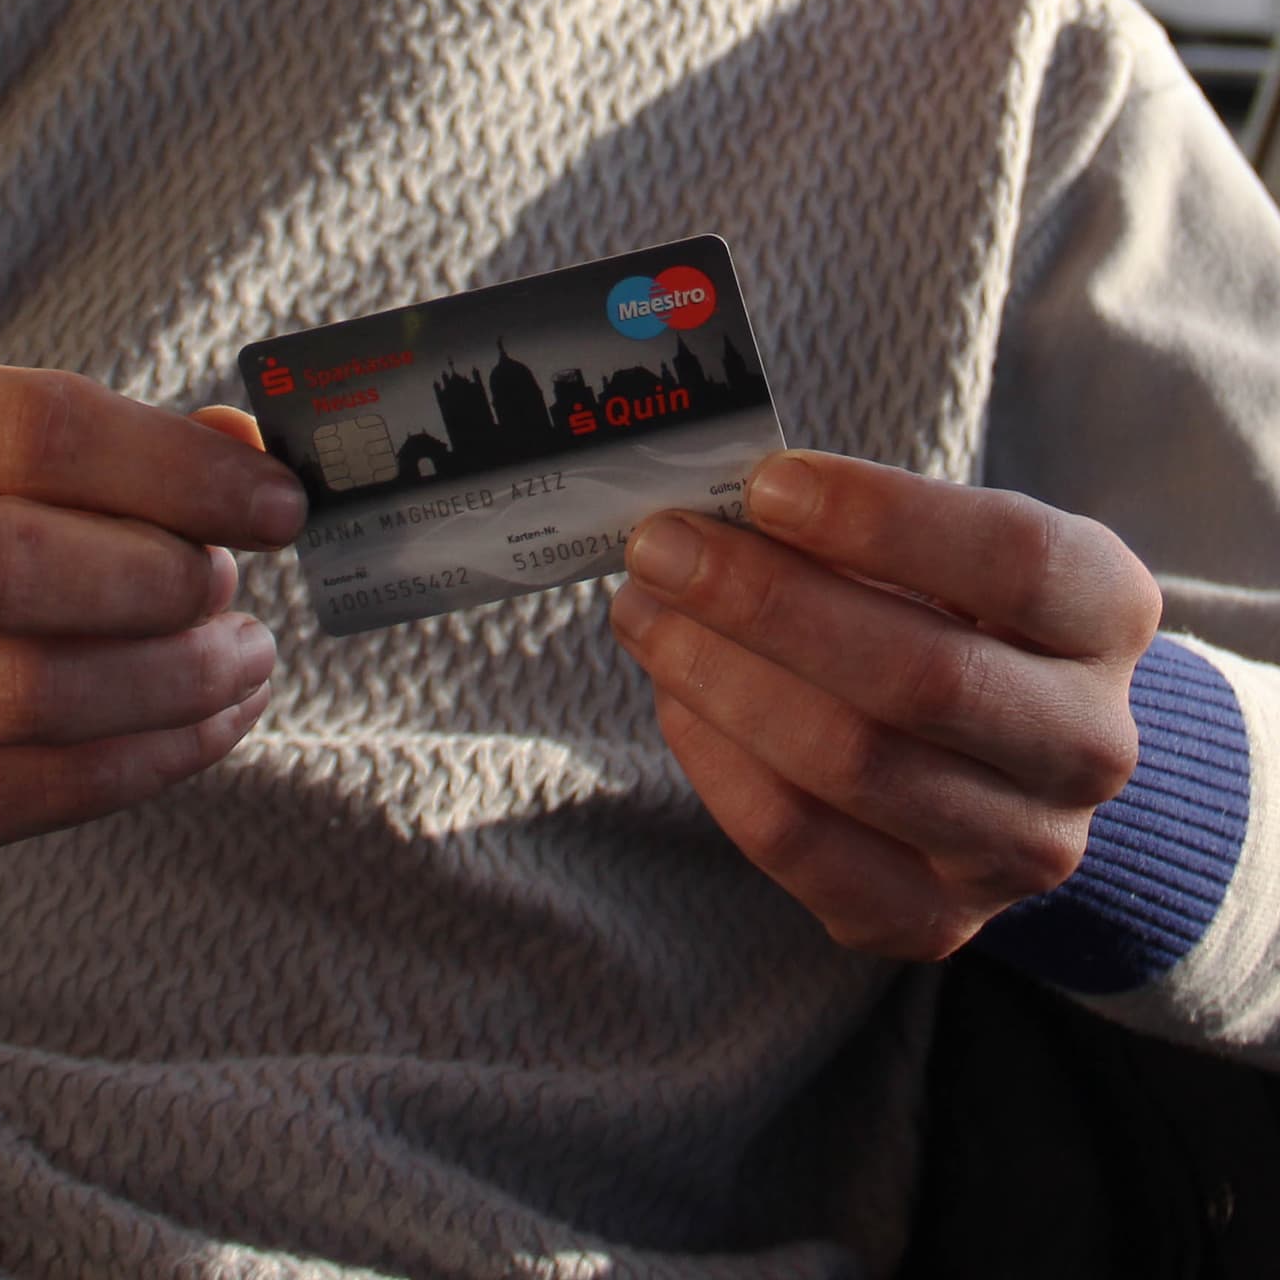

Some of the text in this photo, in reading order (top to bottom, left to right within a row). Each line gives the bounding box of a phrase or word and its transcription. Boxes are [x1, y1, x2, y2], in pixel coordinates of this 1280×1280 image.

[617, 286, 707, 322] Maestro
[302, 350, 415, 390] Sparkasse
[311, 386, 380, 416] Neuss
[605, 385, 691, 429] Quin
[307, 471, 568, 549] DANA MAGHDEED AZIZ
[328, 566, 471, 616] 1001555422
